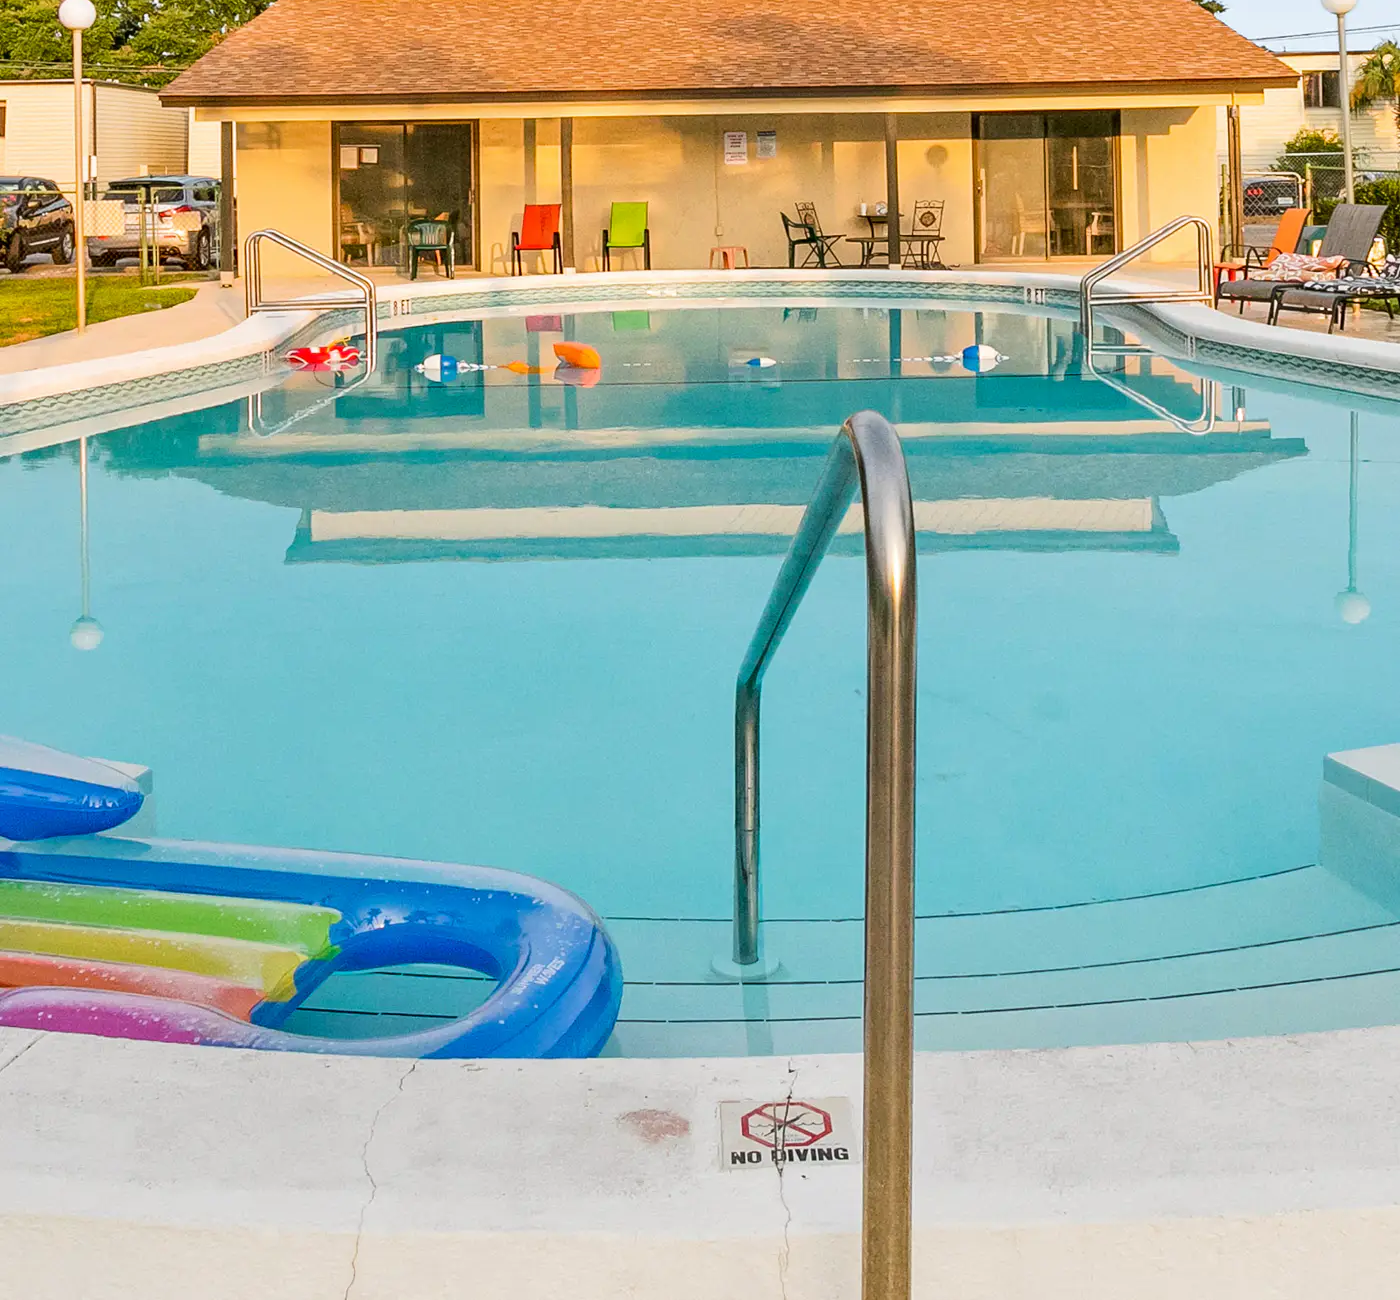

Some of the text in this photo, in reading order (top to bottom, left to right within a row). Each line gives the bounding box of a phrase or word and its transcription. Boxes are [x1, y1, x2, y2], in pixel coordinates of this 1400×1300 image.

[534, 956, 566, 986] WAVES
[731, 1147, 850, 1164] NO DIVING
